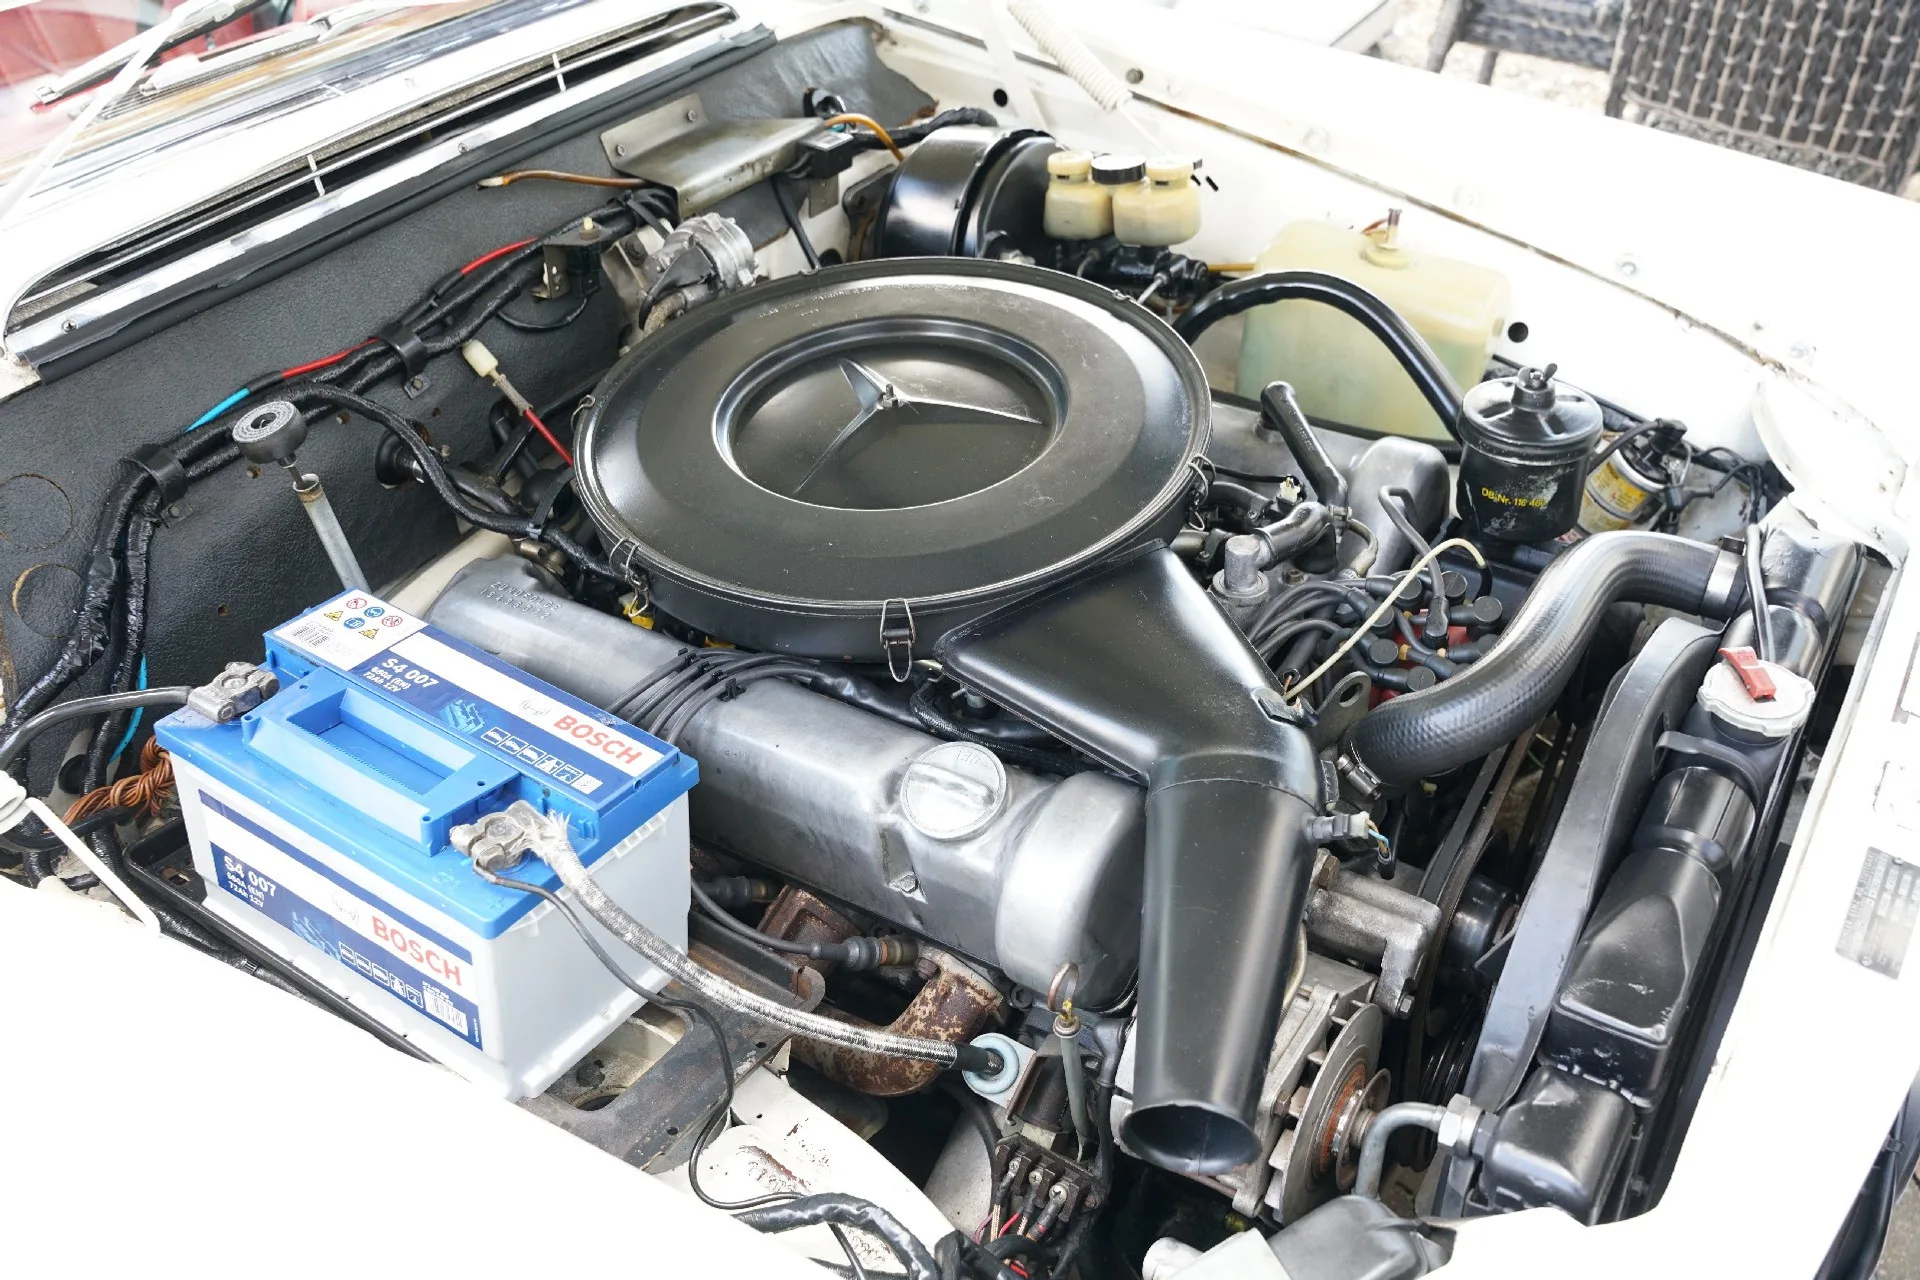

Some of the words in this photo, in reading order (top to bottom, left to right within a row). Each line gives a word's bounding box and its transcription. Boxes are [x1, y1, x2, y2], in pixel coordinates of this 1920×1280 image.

[1514, 497, 1528, 507] 116
[363, 671, 385, 684] 72Ah
[383, 682, 401, 692] 12V
[382, 658, 408, 673] S4
[404, 669, 439, 688] 007
[553, 714, 642, 764] BOSCH
[224, 855, 246, 878] S4
[248, 870, 276, 897] 007
[371, 915, 462, 986] BOSCH
